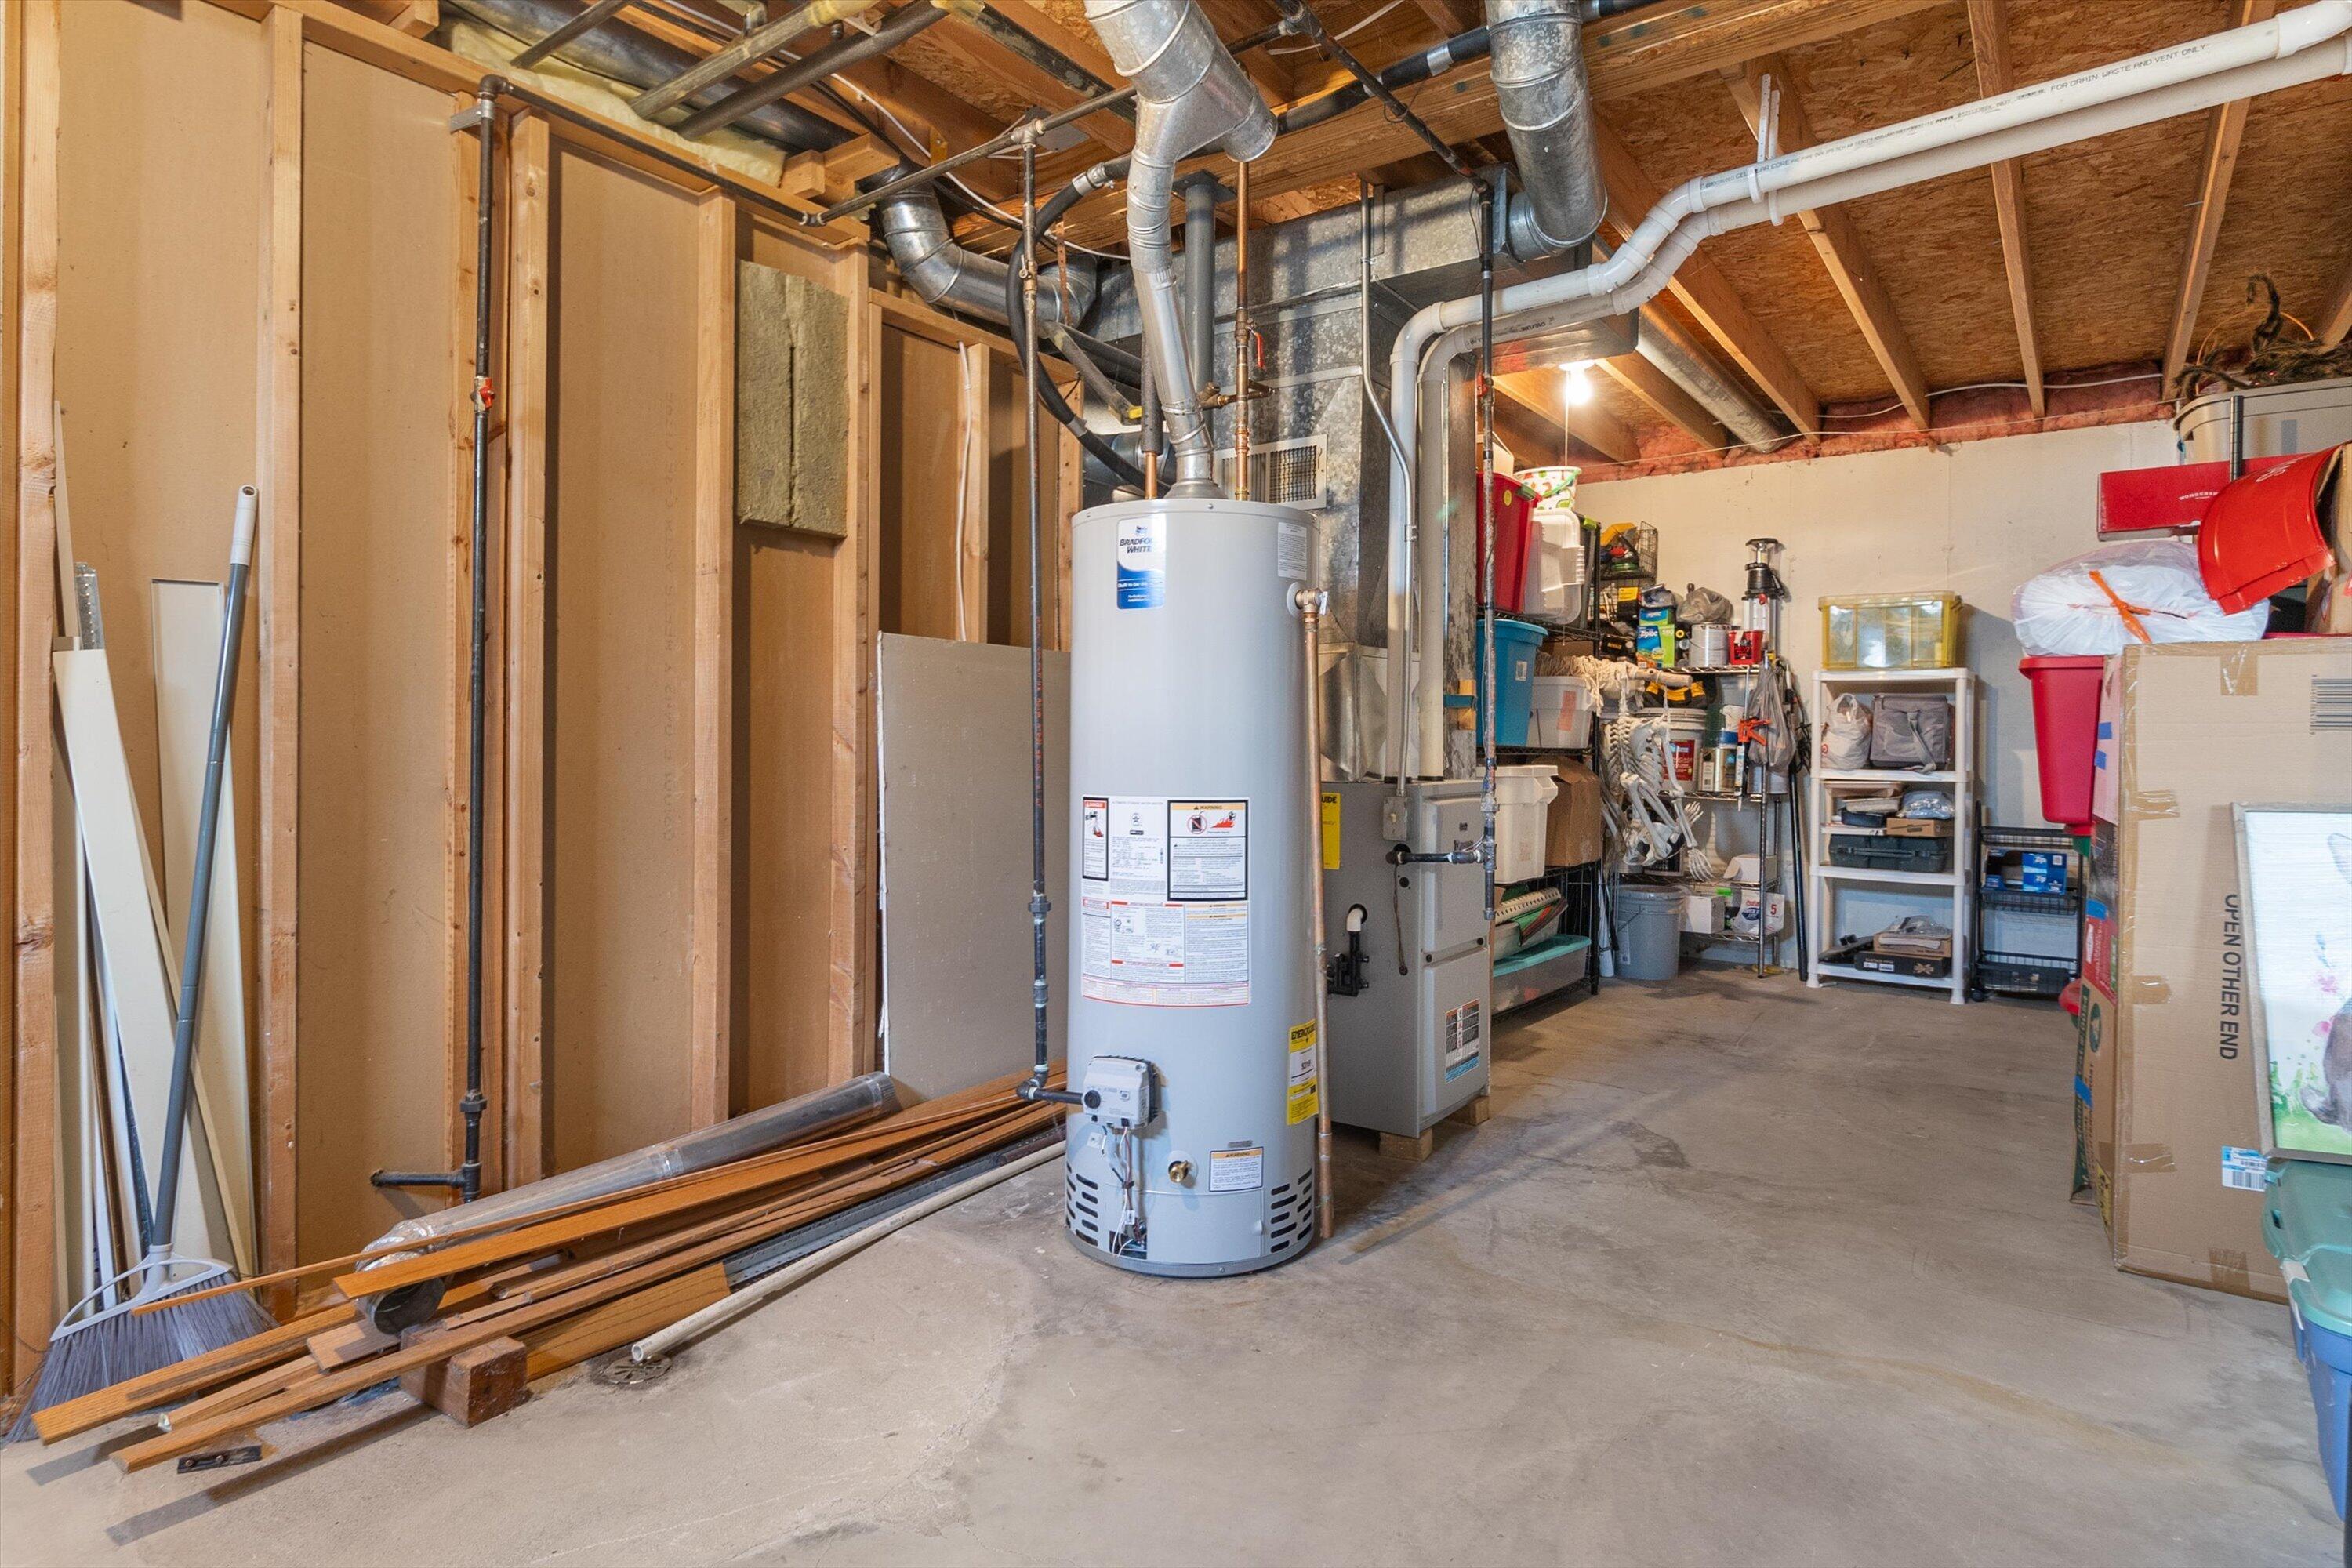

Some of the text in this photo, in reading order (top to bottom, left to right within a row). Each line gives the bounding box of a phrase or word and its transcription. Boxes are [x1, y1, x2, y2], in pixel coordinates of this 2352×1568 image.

[2050, 44, 2206, 91] FOR DRAIN WASTE AND VENT ONLY
[1770, 159, 1790, 170] CORE
[1770, 904, 1777, 915] 5
[2220, 951, 2241, 1017] OTHER
[2220, 1020, 2238, 1060] END
